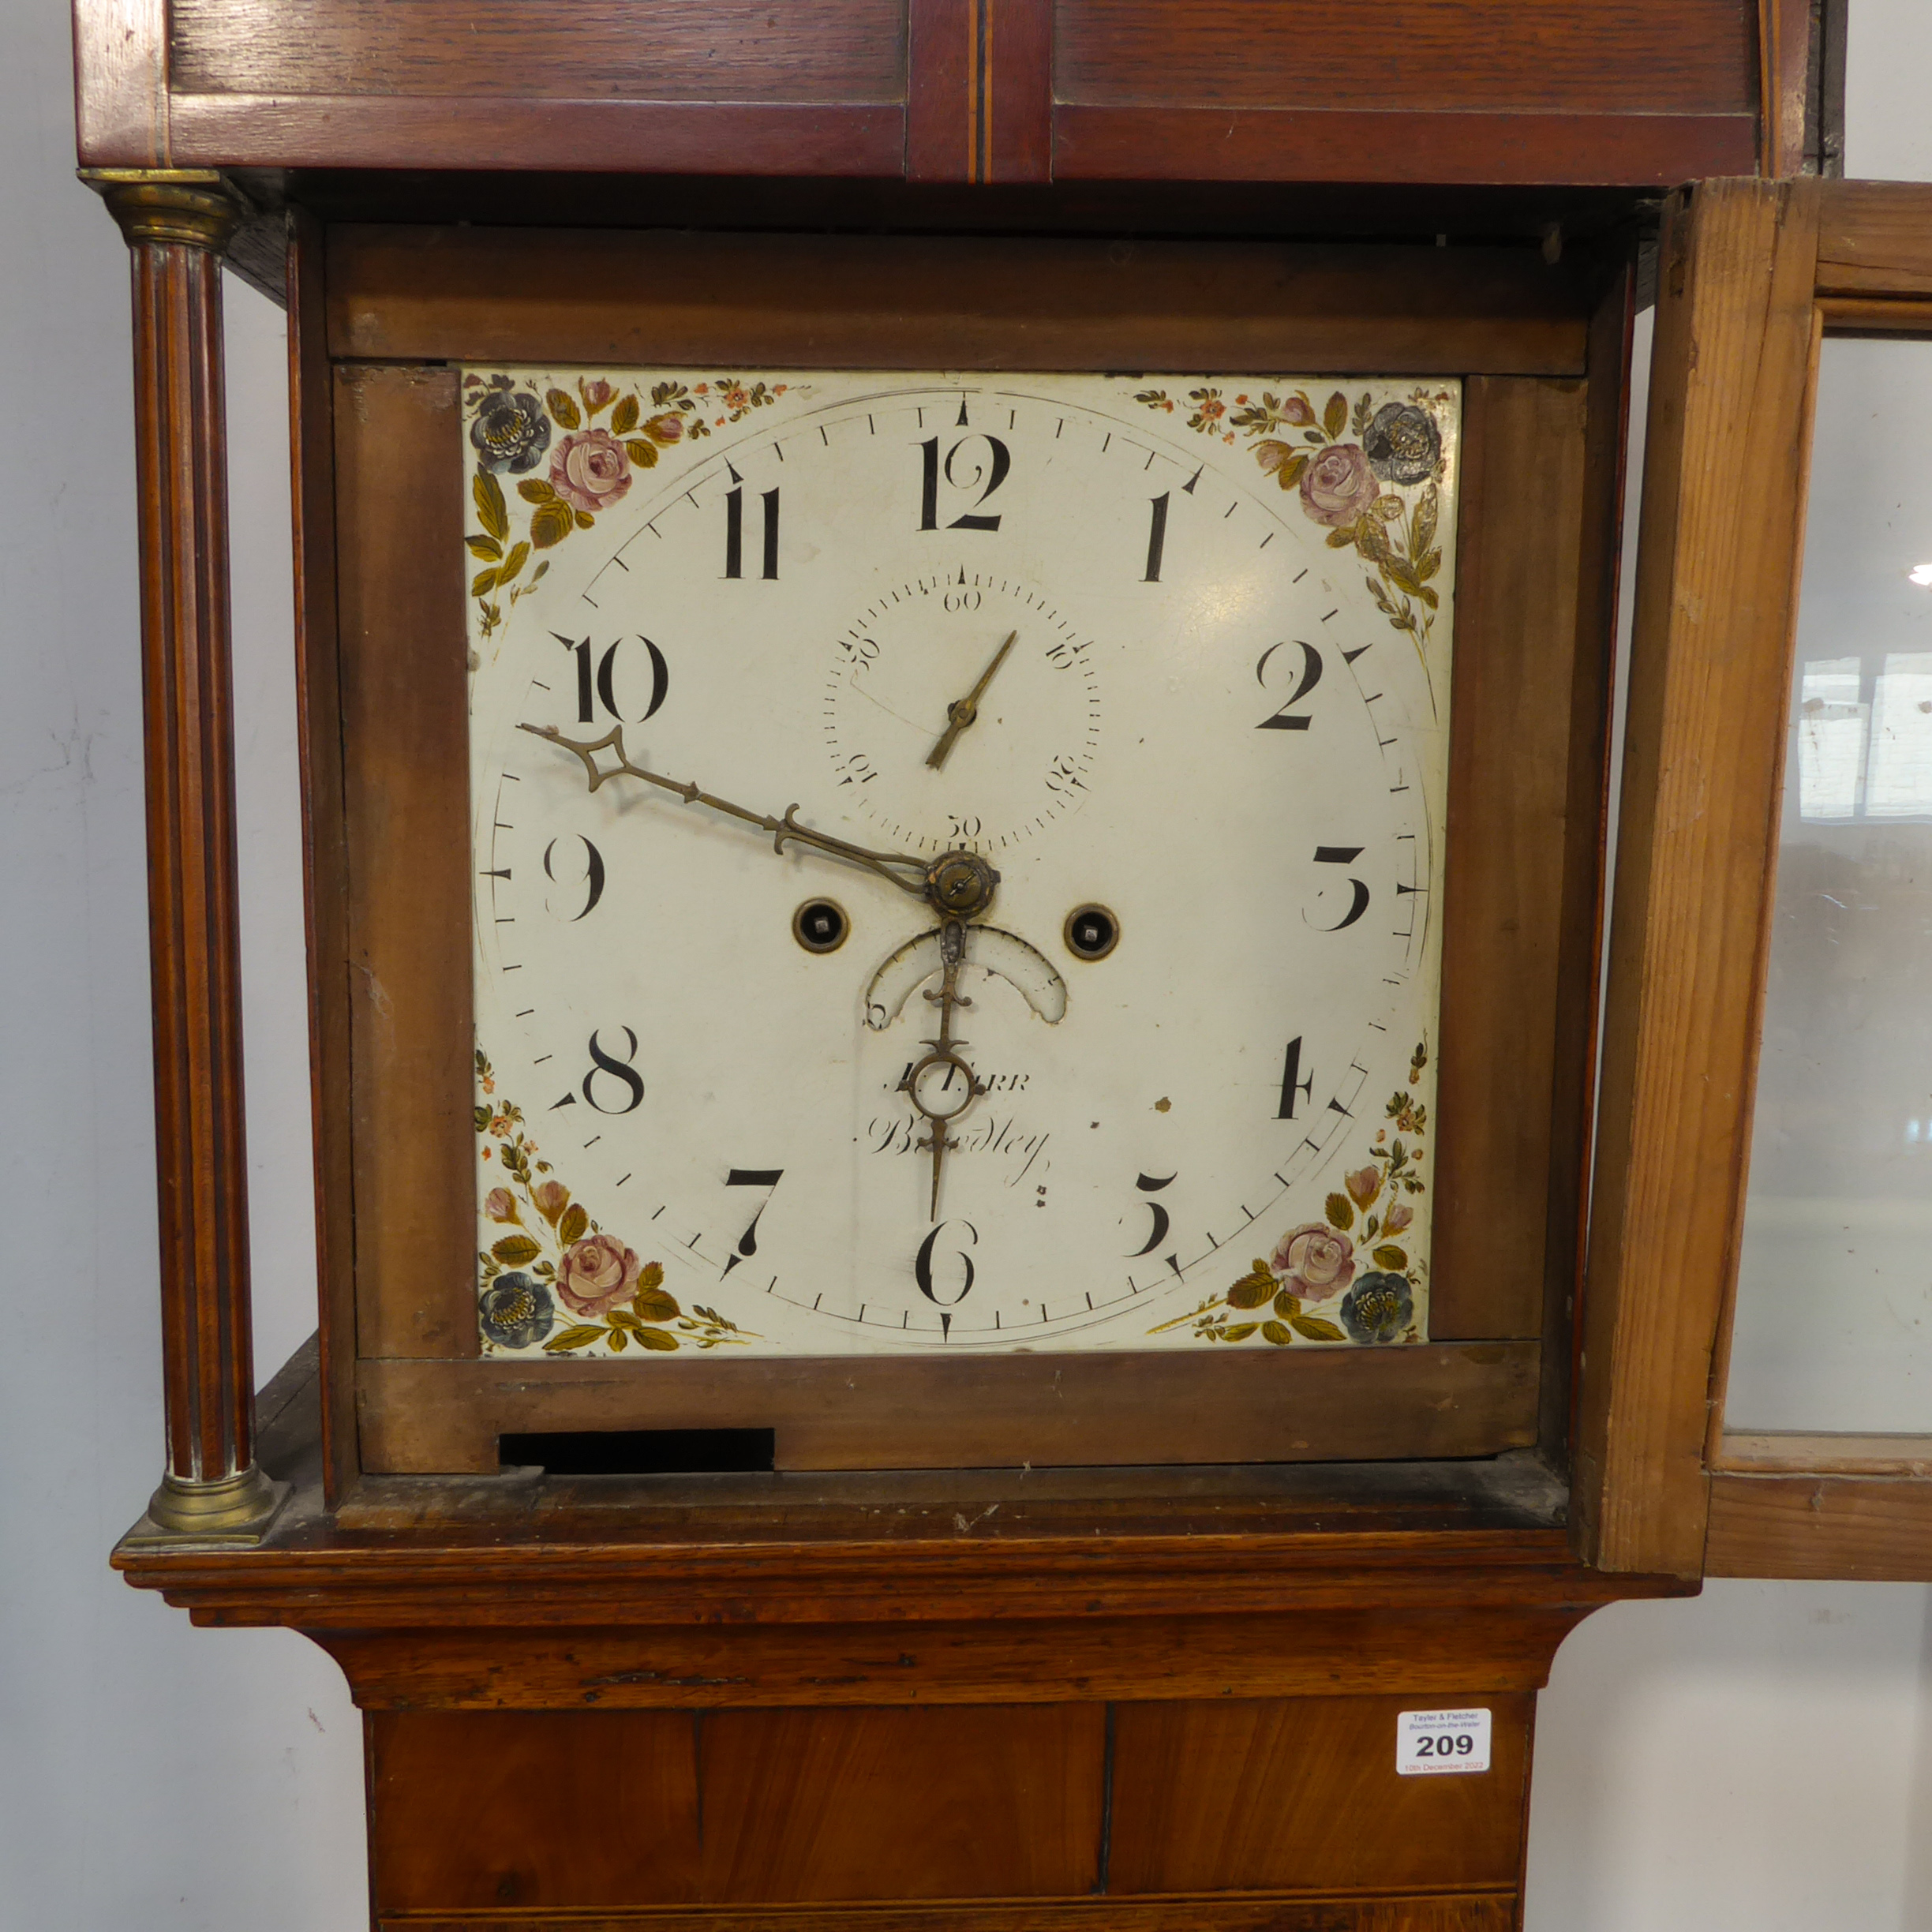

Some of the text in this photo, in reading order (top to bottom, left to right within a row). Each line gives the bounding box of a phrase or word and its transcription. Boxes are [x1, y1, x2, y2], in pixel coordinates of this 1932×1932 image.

[919, 433, 1010, 532] 12
[718, 485, 780, 581] 11
[1139, 490, 1170, 583] 1
[943, 590, 982, 612] 60
[572, 634, 669, 724] 10
[1255, 640, 1324, 731] 2
[543, 833, 605, 923] 9
[1301, 845, 1370, 932] 3
[582, 1025, 645, 1115] 8
[1269, 1035, 1314, 1120] 4
[725, 1168, 785, 1258] 7
[1123, 1171, 1178, 1258] 5
[915, 1220, 978, 1307] 6
[1416, 1735, 1473, 1757] 209
